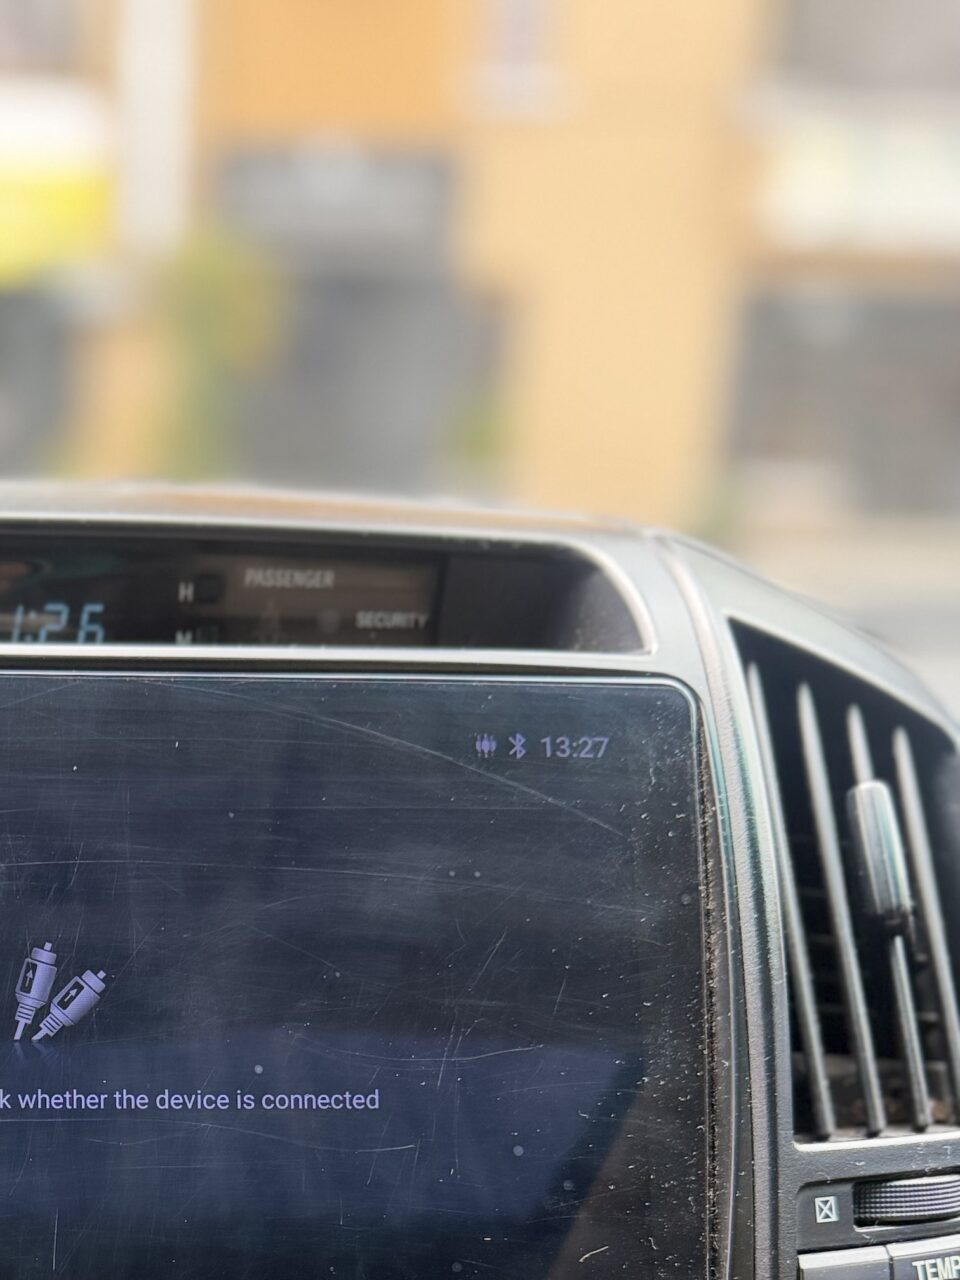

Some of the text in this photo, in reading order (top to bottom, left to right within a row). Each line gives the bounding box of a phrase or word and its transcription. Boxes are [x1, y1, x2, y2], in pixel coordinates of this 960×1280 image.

[244, 569, 334, 588] PASSENGER
[178, 583, 194, 602] H
[355, 611, 428, 629] SECURITY
[540, 736, 609, 758] 13:27
[18, 1089, 108, 1109] whether
[114, 1090, 149, 1109] the
[155, 1089, 230, 1109] device
[236, 1090, 255, 1109] is
[261, 1089, 380, 1109] connected
